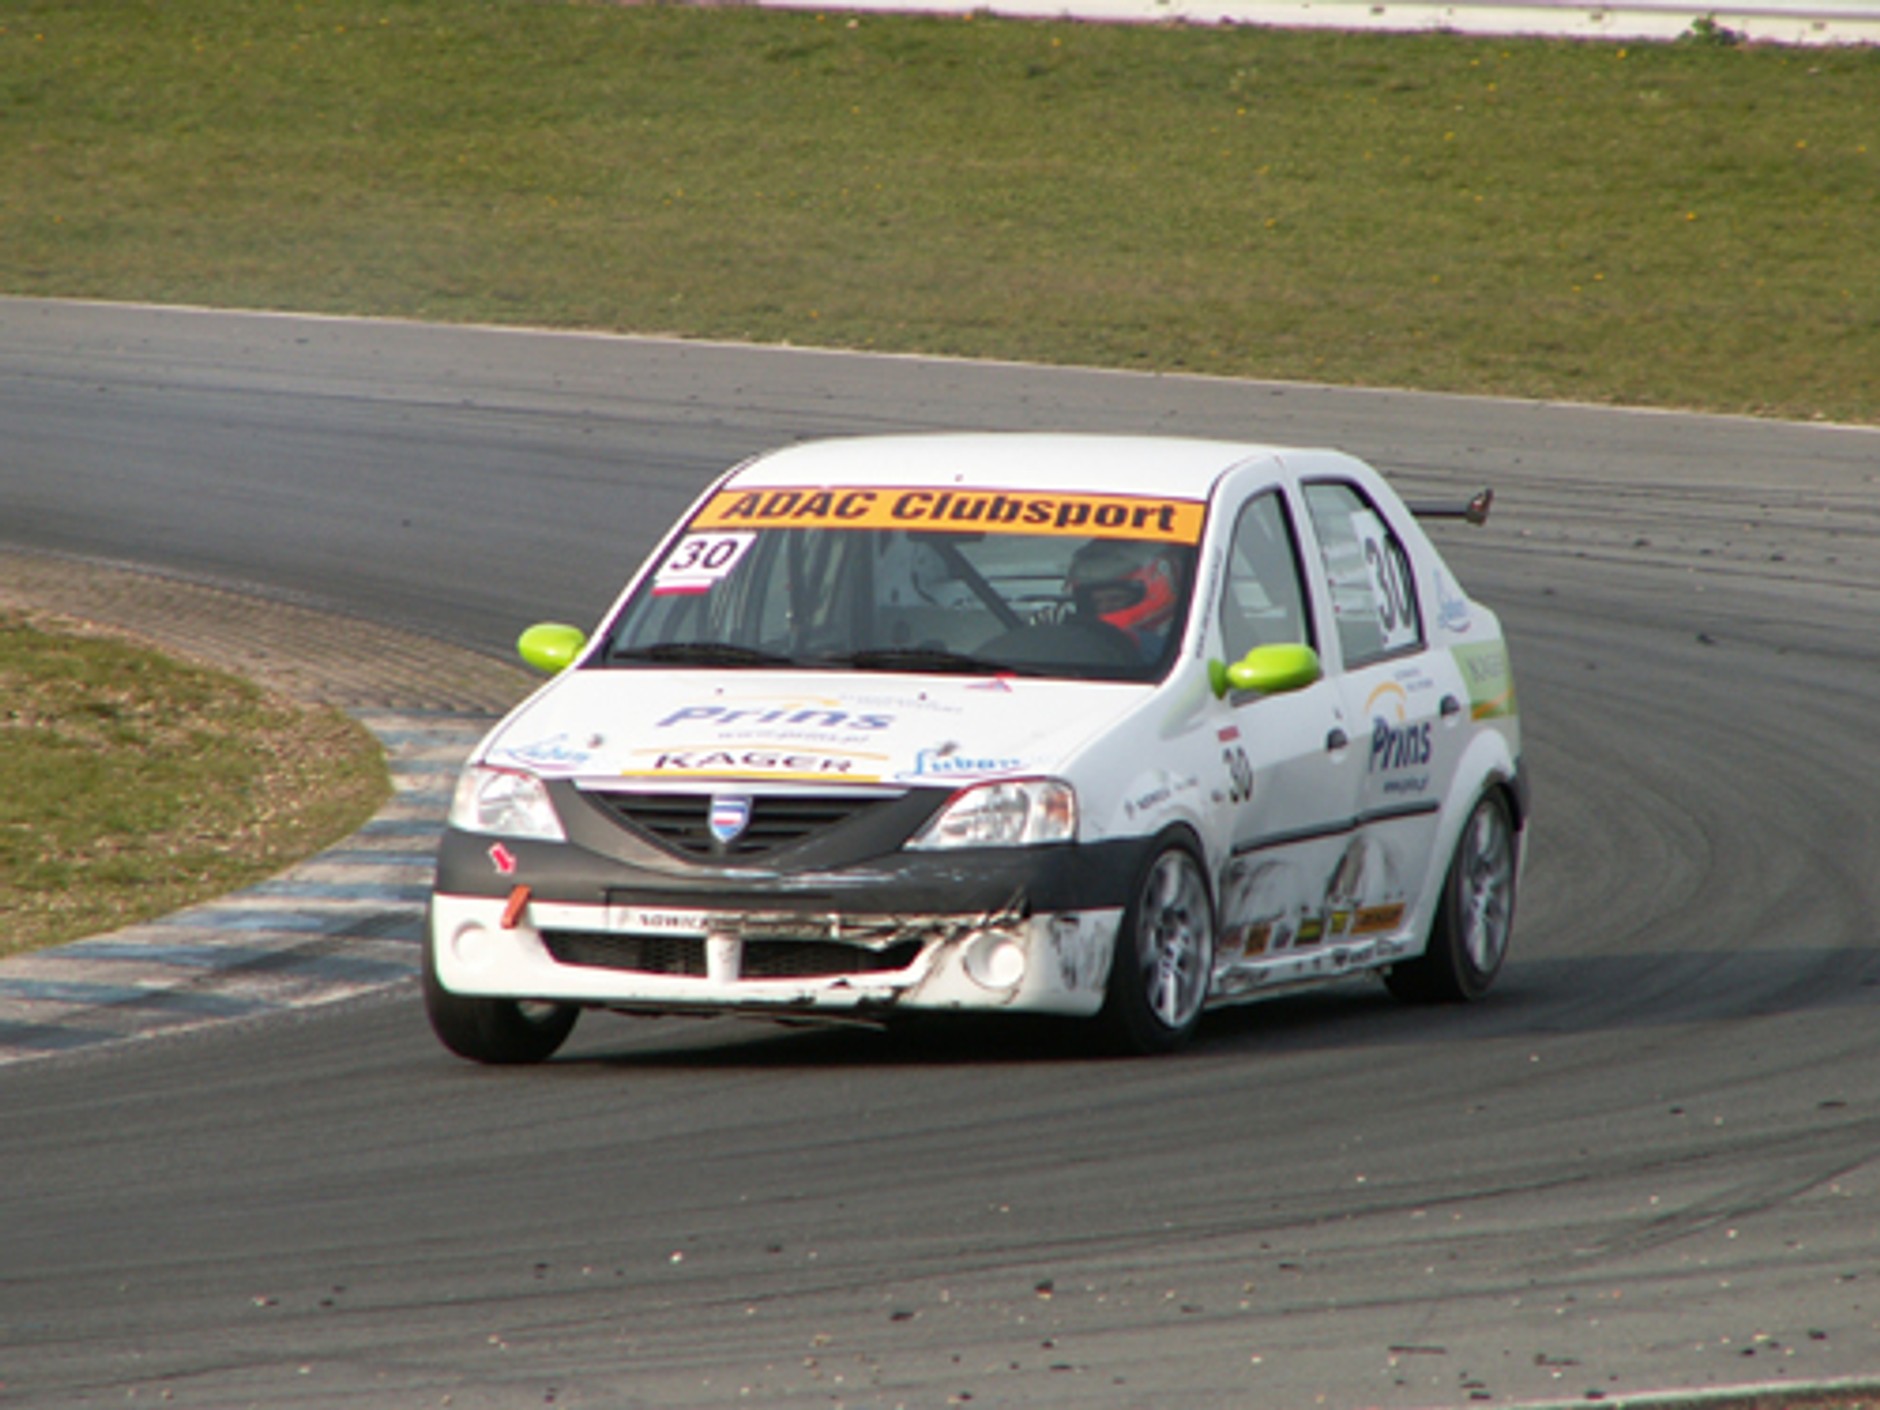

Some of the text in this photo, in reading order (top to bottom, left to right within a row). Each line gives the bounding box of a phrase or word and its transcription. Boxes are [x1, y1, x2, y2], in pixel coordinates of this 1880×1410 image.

[720, 489, 1178, 532] ADAC Clubsport
[669, 538, 739, 571] 30
[1364, 533, 1413, 633] 30
[655, 706, 896, 730] Prins
[654, 751, 852, 773] KAGER
[1369, 715, 1433, 773] Prins
[1223, 746, 1254, 804] 30
